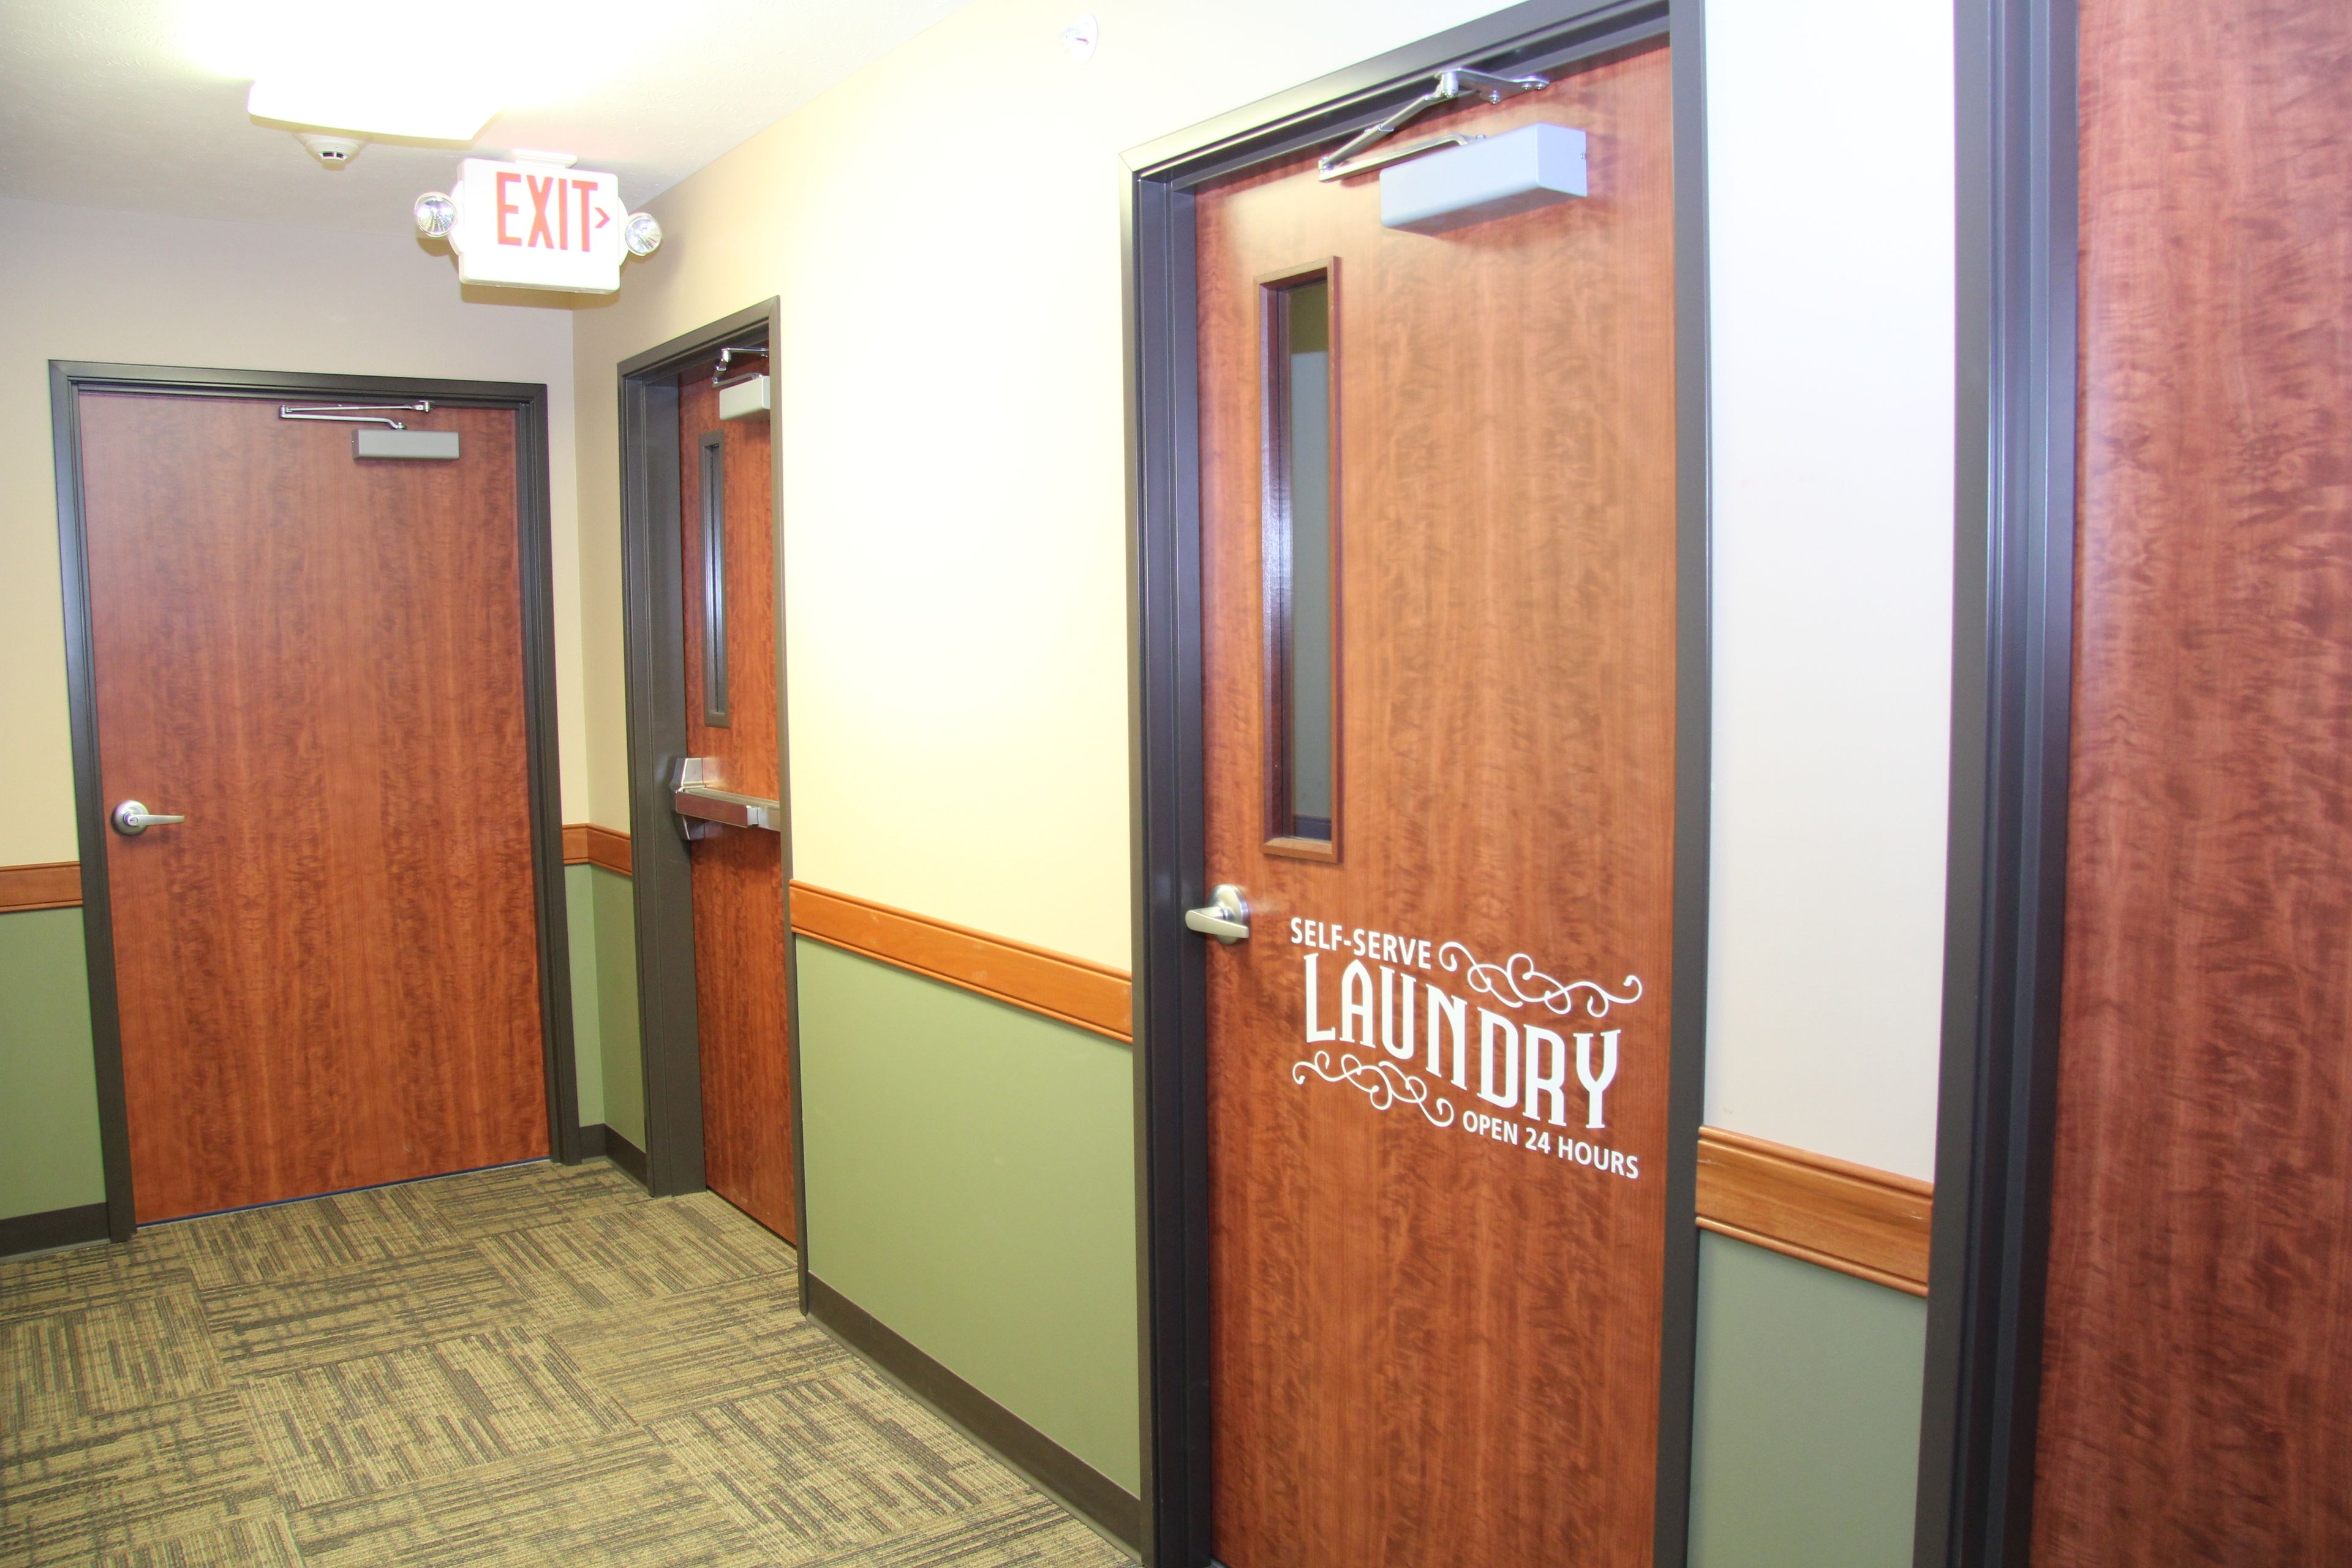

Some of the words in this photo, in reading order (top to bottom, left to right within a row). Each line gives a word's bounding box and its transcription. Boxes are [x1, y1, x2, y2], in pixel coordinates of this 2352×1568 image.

[496, 172, 598, 252] EXIT
[1291, 917, 1431, 970] SELF-SERVE
[1303, 952, 1621, 1129] LAUNDRY
[1463, 1110, 1518, 1145] OPEN
[1525, 1127, 1551, 1154] 24
[1558, 1136, 1638, 1179] HOURS
